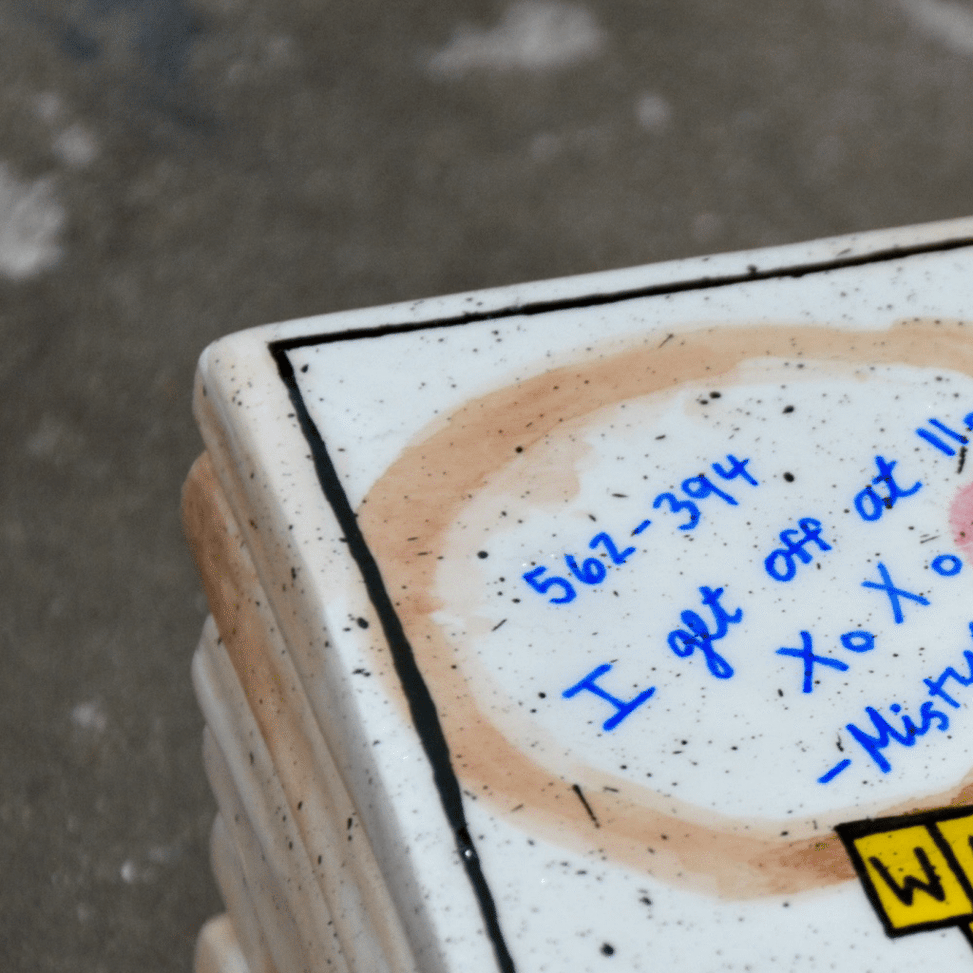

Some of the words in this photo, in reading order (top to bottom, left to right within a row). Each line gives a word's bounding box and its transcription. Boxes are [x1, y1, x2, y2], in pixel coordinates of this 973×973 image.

[522, 454, 759, 605] 562-394
[562, 662, 656, 732] I
[667, 586, 743, 680] get
[764, 517, 832, 582] off
[853, 455, 923, 522] at
